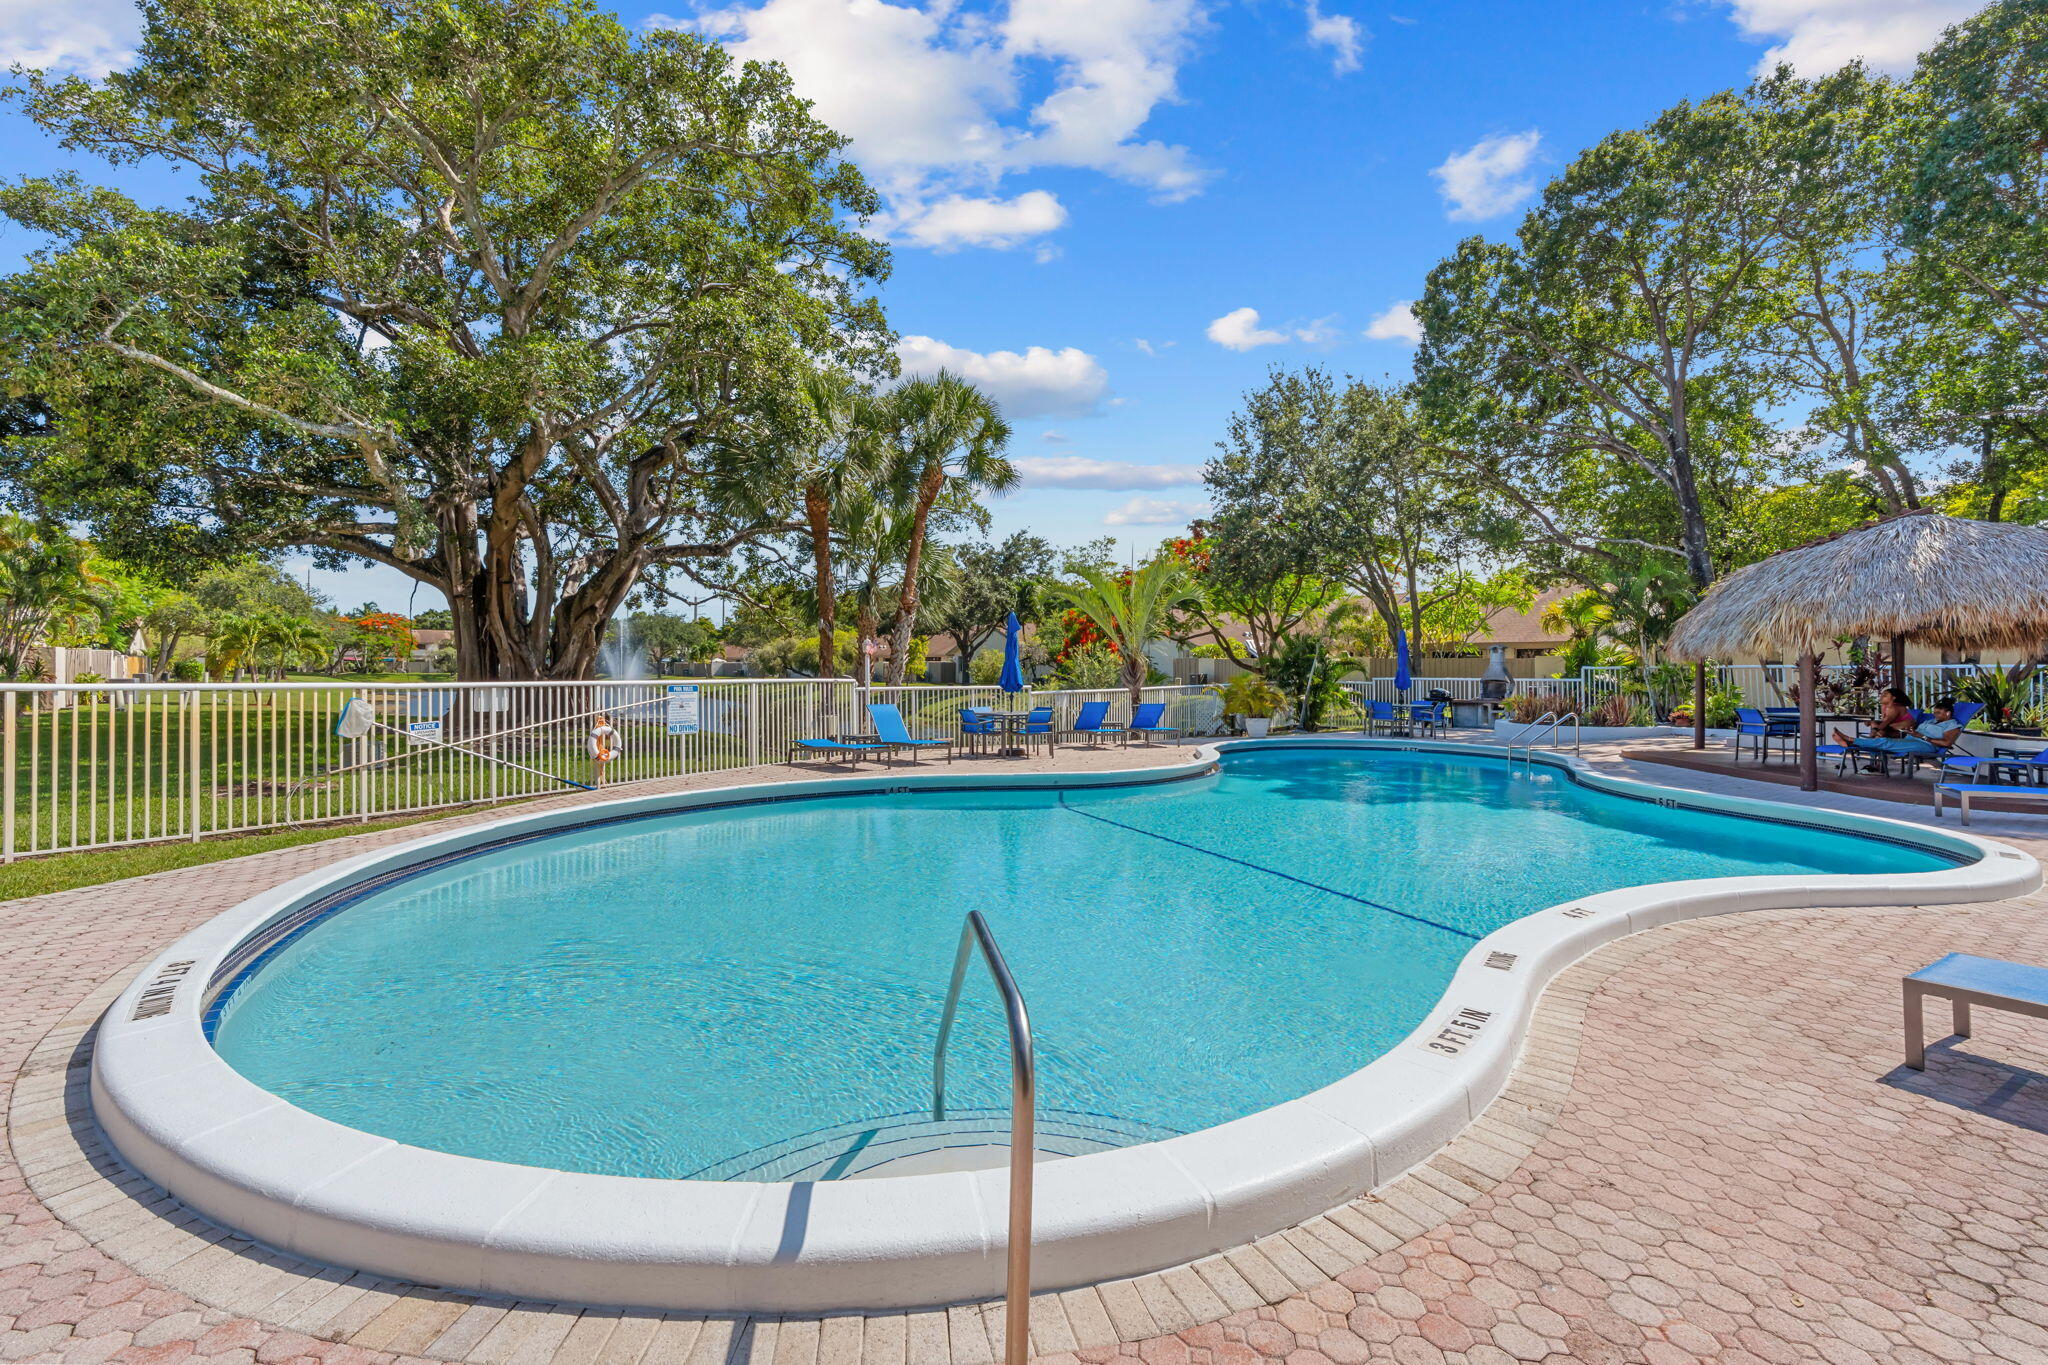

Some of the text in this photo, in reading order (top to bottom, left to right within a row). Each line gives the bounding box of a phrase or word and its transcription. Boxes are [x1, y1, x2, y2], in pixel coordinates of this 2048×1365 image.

[414, 722, 436, 730] NOTICE
[670, 724, 698, 732] NO DIVING
[1570, 907, 1596, 917] FT
[157, 967, 192, 979] FT
[140, 986, 177, 1000] IN
[1428, 1008, 1492, 1054] 3 FT 5 IN
